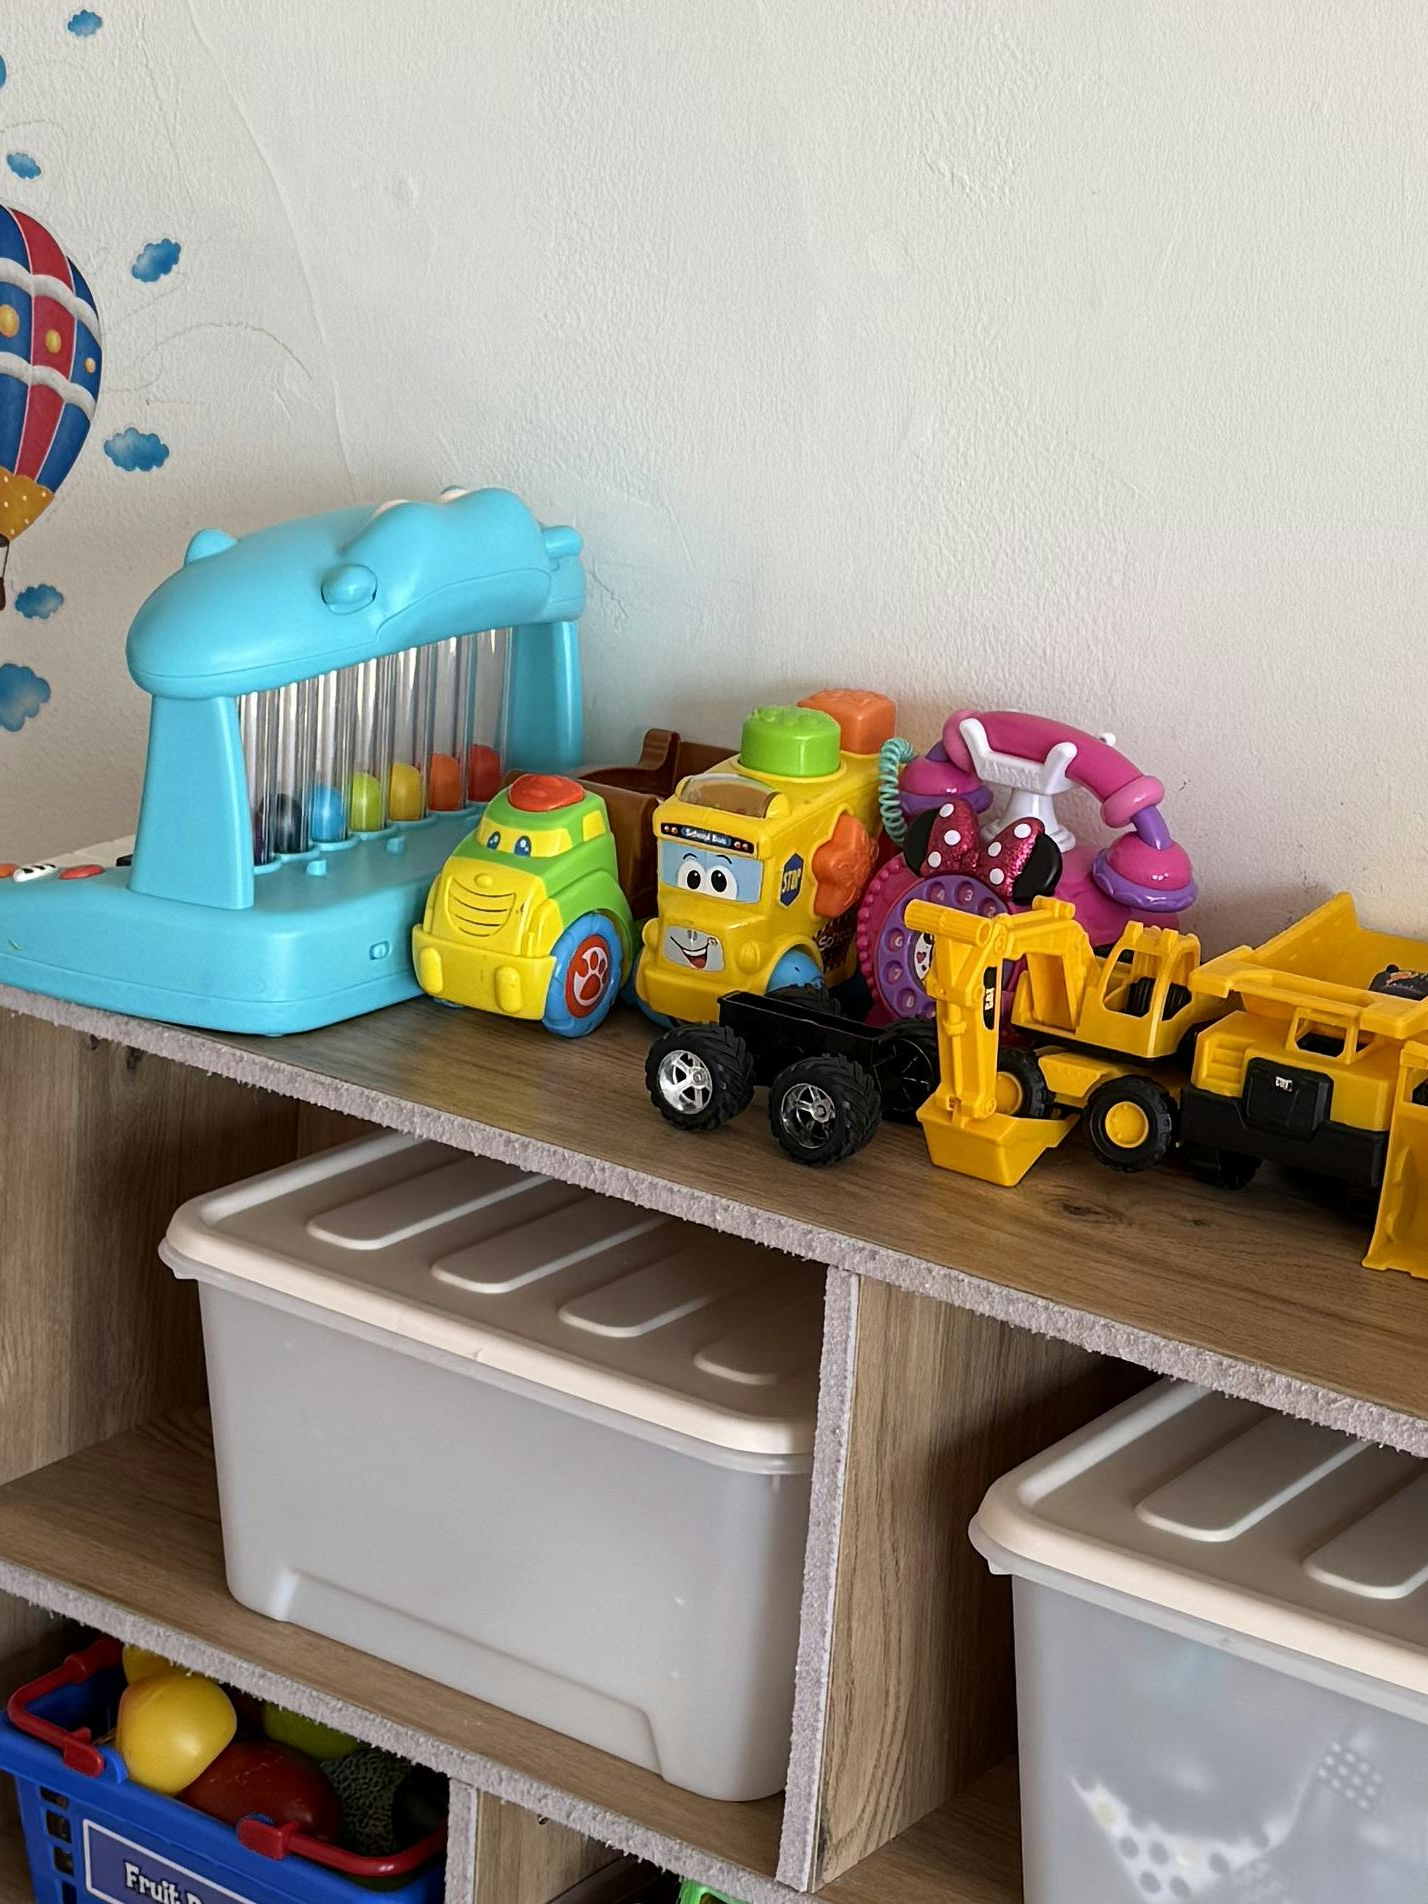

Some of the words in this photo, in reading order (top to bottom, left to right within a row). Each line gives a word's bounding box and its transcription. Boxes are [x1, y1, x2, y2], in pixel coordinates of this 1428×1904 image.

[782, 868, 802, 893] STOP
[965, 889, 975, 902] 3
[893, 937, 903, 948] 6
